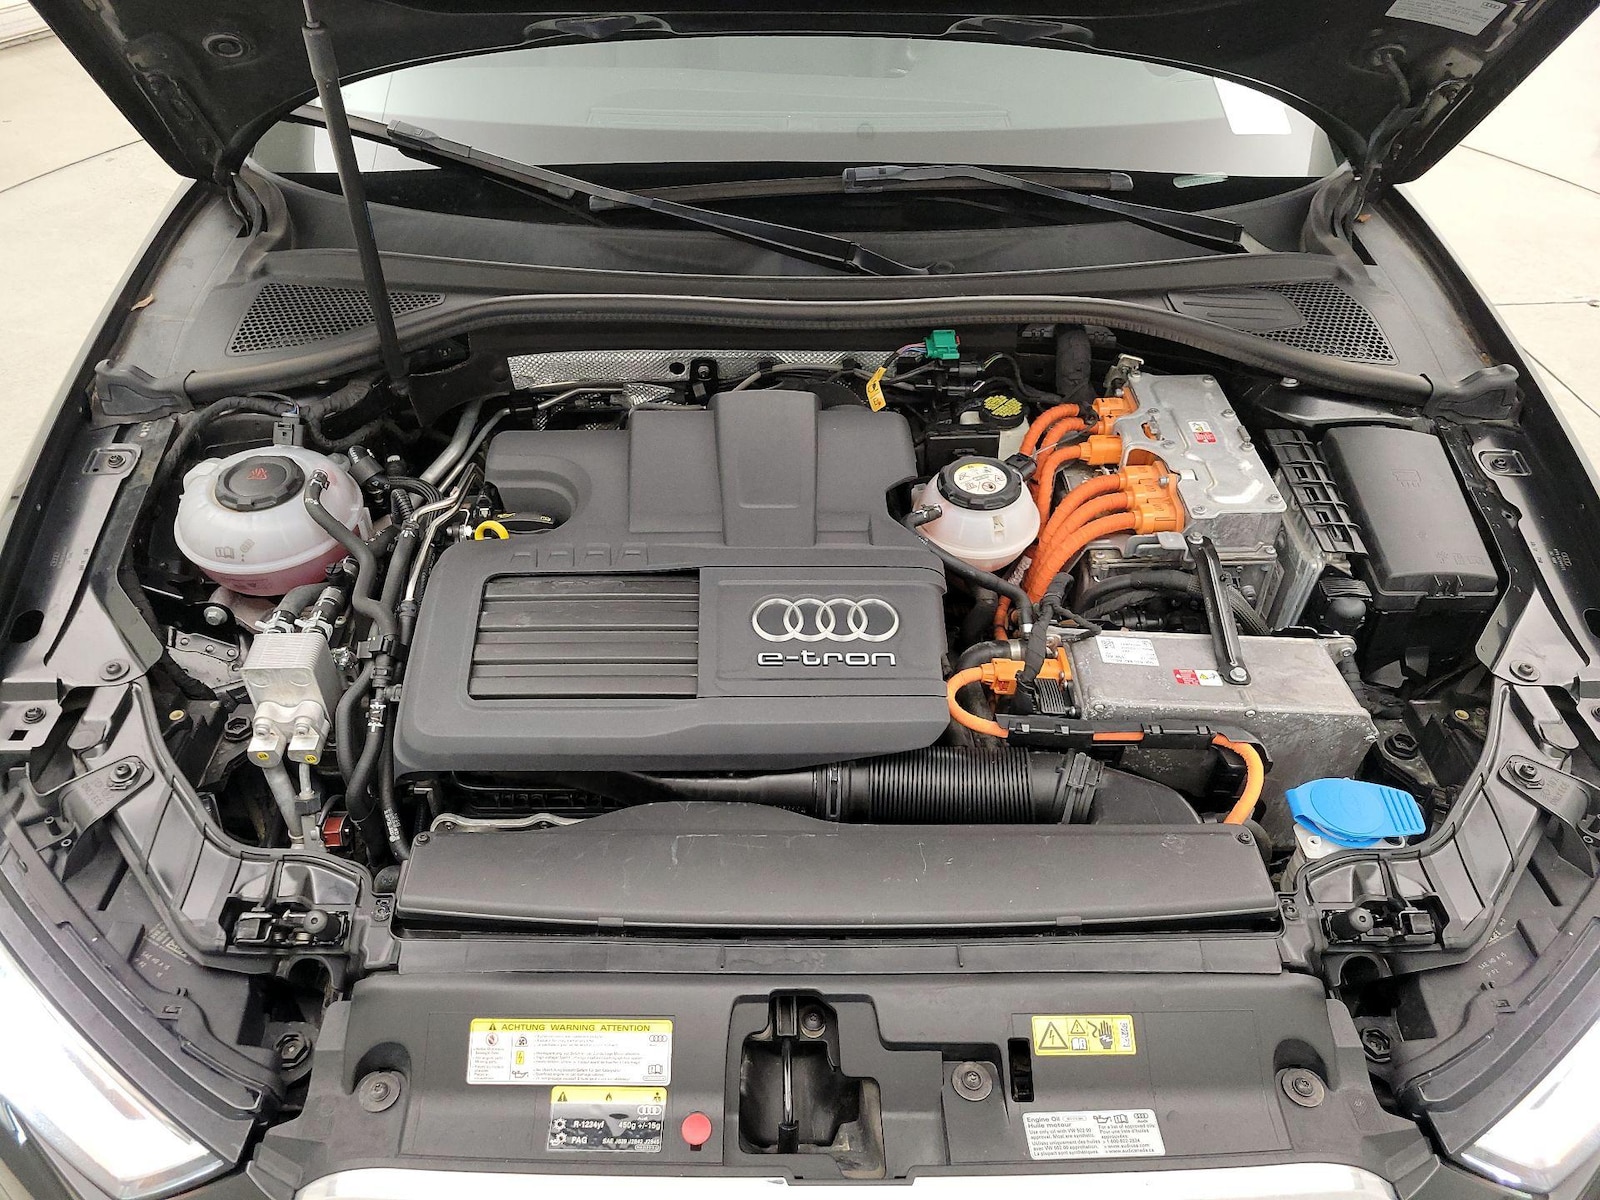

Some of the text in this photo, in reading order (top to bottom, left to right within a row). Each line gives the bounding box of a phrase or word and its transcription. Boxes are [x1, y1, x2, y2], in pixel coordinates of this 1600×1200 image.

[757, 650, 896, 666] e-tron
[550, 1024, 595, 1032] WARNING
[600, 1024, 650, 1032] ATTENTION
[573, 1120, 661, 1131] R-1234yf 450g +/-15g
[571, 1136, 588, 1144] PAG
